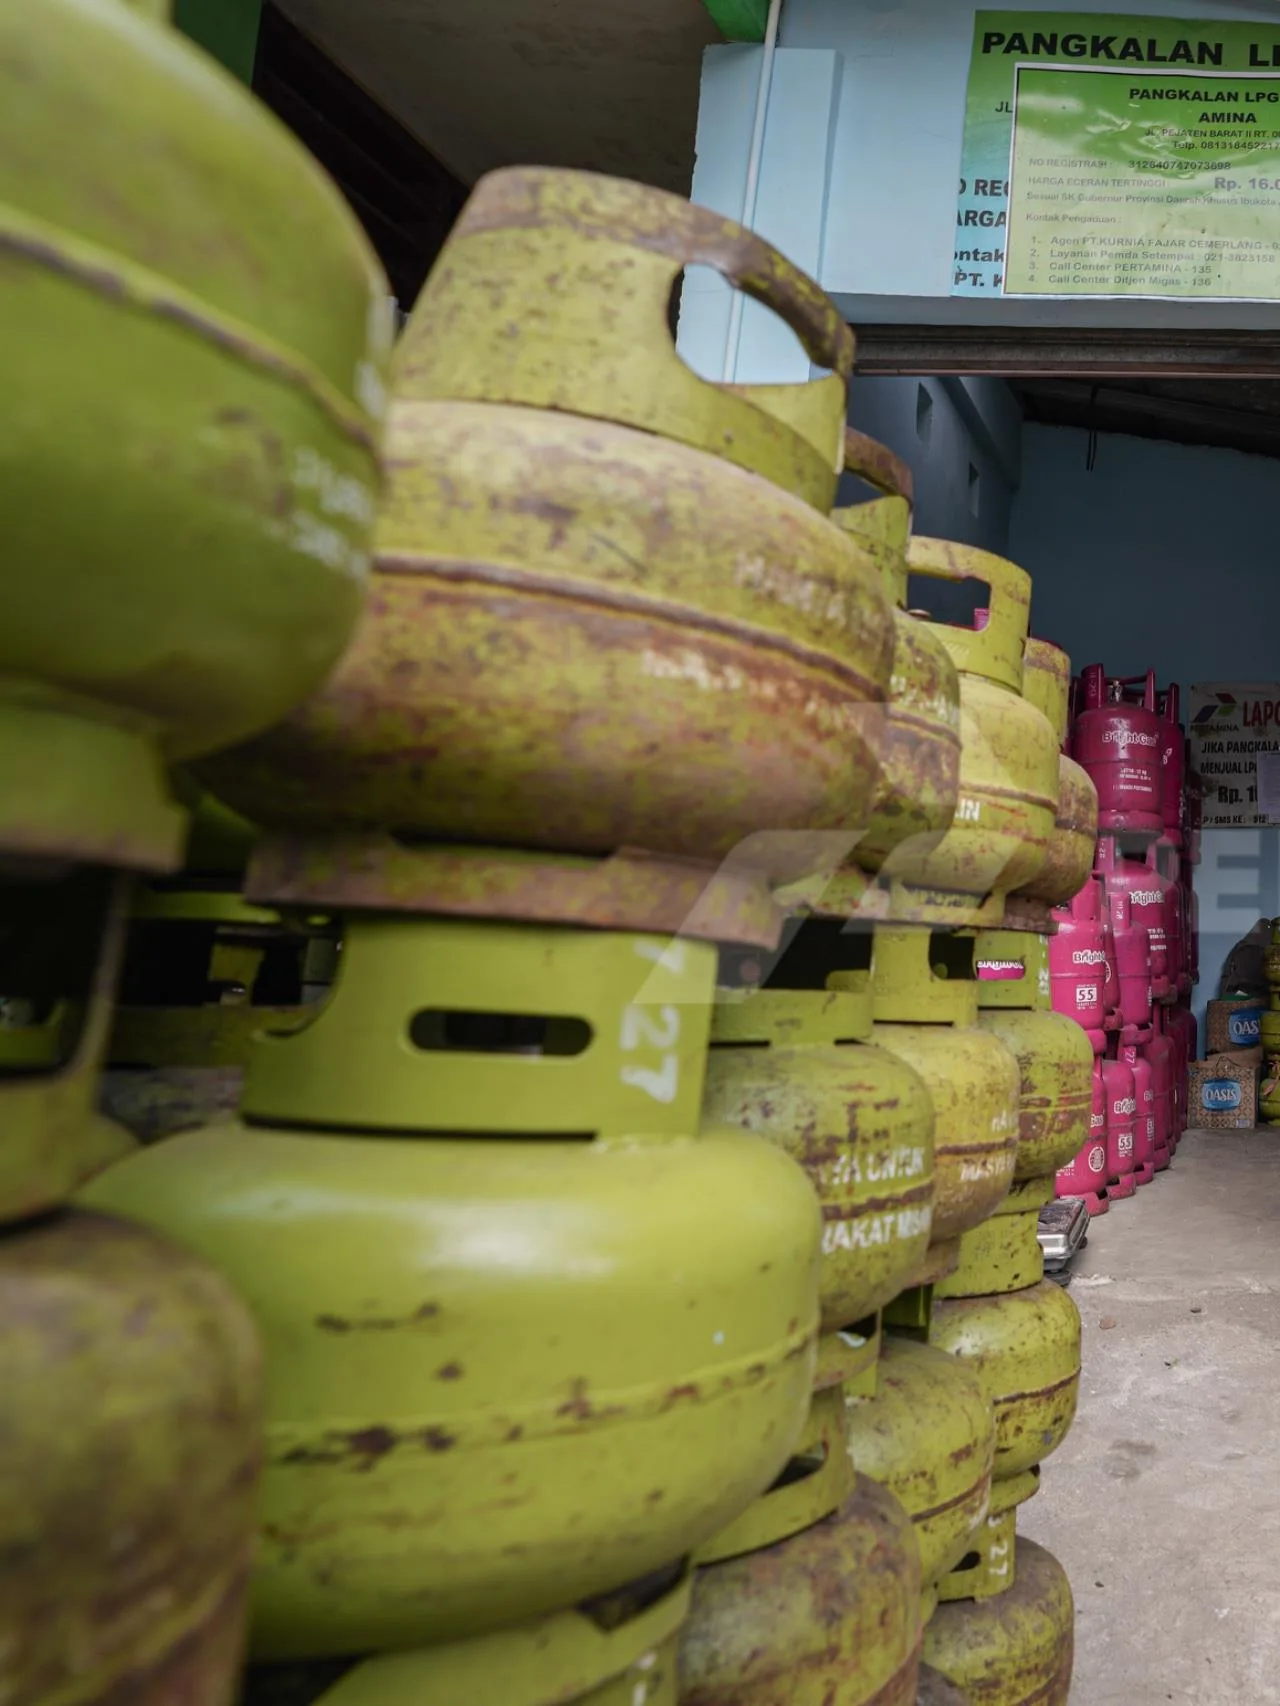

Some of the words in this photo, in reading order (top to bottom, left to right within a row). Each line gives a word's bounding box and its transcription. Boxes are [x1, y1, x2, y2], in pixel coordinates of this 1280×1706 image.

[983, 32, 1223, 66] PANGKALAN
[1129, 88, 1239, 103] PANGKALAN
[1245, 92, 1279, 103] LPG
[1198, 112, 1257, 124] AMINA
[1162, 129, 1207, 138] PEJATEN
[1209, 130, 1244, 138] BARAT
[1173, 141, 1197, 150] Telp.
[1028, 177, 1063, 186] HARGA
[1067, 178, 1108, 187] ECERAN
[1111, 178, 1166, 187] TERTINGGI
[1214, 177, 1241, 192] Rp.
[1125, 195, 1163, 203] Provinsi
[1026, 213, 1060, 222] Kontak
[1062, 214, 1116, 224] Pengaduan
[1050, 236, 1080, 246] Agen
[1148, 239, 1186, 248] FAJAR
[1189, 239, 1262, 250] CEMERLANG
[1050, 249, 1097, 259] Layanan
[1100, 250, 1139, 259] Pemda
[1049, 262, 1071, 271] Call
[1073, 262, 1112, 271] Center
[1114, 263, 1182, 273] PERTAMINA
[1192, 265, 1212, 274] 135
[1048, 275, 1070, 284] Call
[1072, 275, 1110, 284] Center
[1149, 277, 1182, 287] Migas
[1201, 741, 1225, 754] JIKA
[1200, 761, 1242, 774] MENJUAL
[1218, 784, 1243, 805] Rp.
[1078, 989, 1095, 1001] 55
[1204, 1086, 1237, 1101] OASIS
